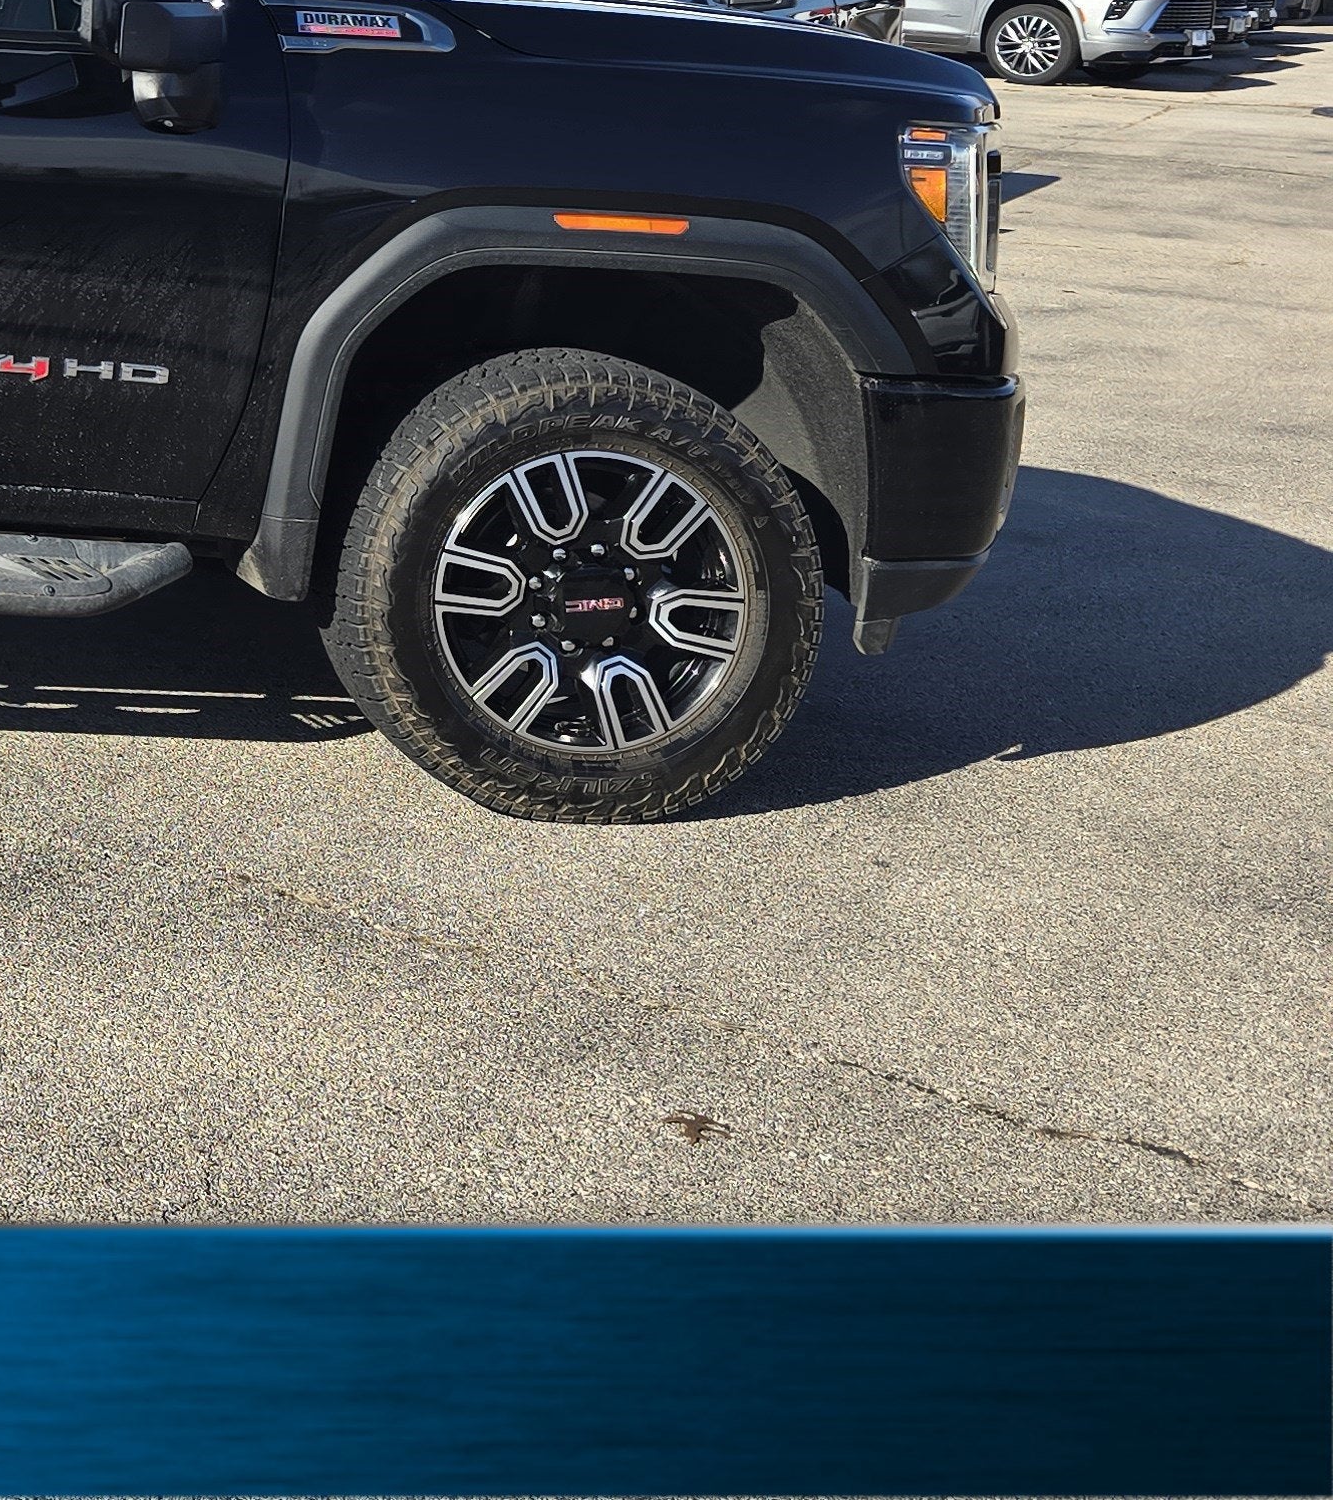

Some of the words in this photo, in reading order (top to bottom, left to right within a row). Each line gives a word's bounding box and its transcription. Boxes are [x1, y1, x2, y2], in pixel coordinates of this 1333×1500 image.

[302, 12, 394, 29] DURAMAX
[62, 358, 170, 385] HD
[564, 597, 625, 614] GMC
